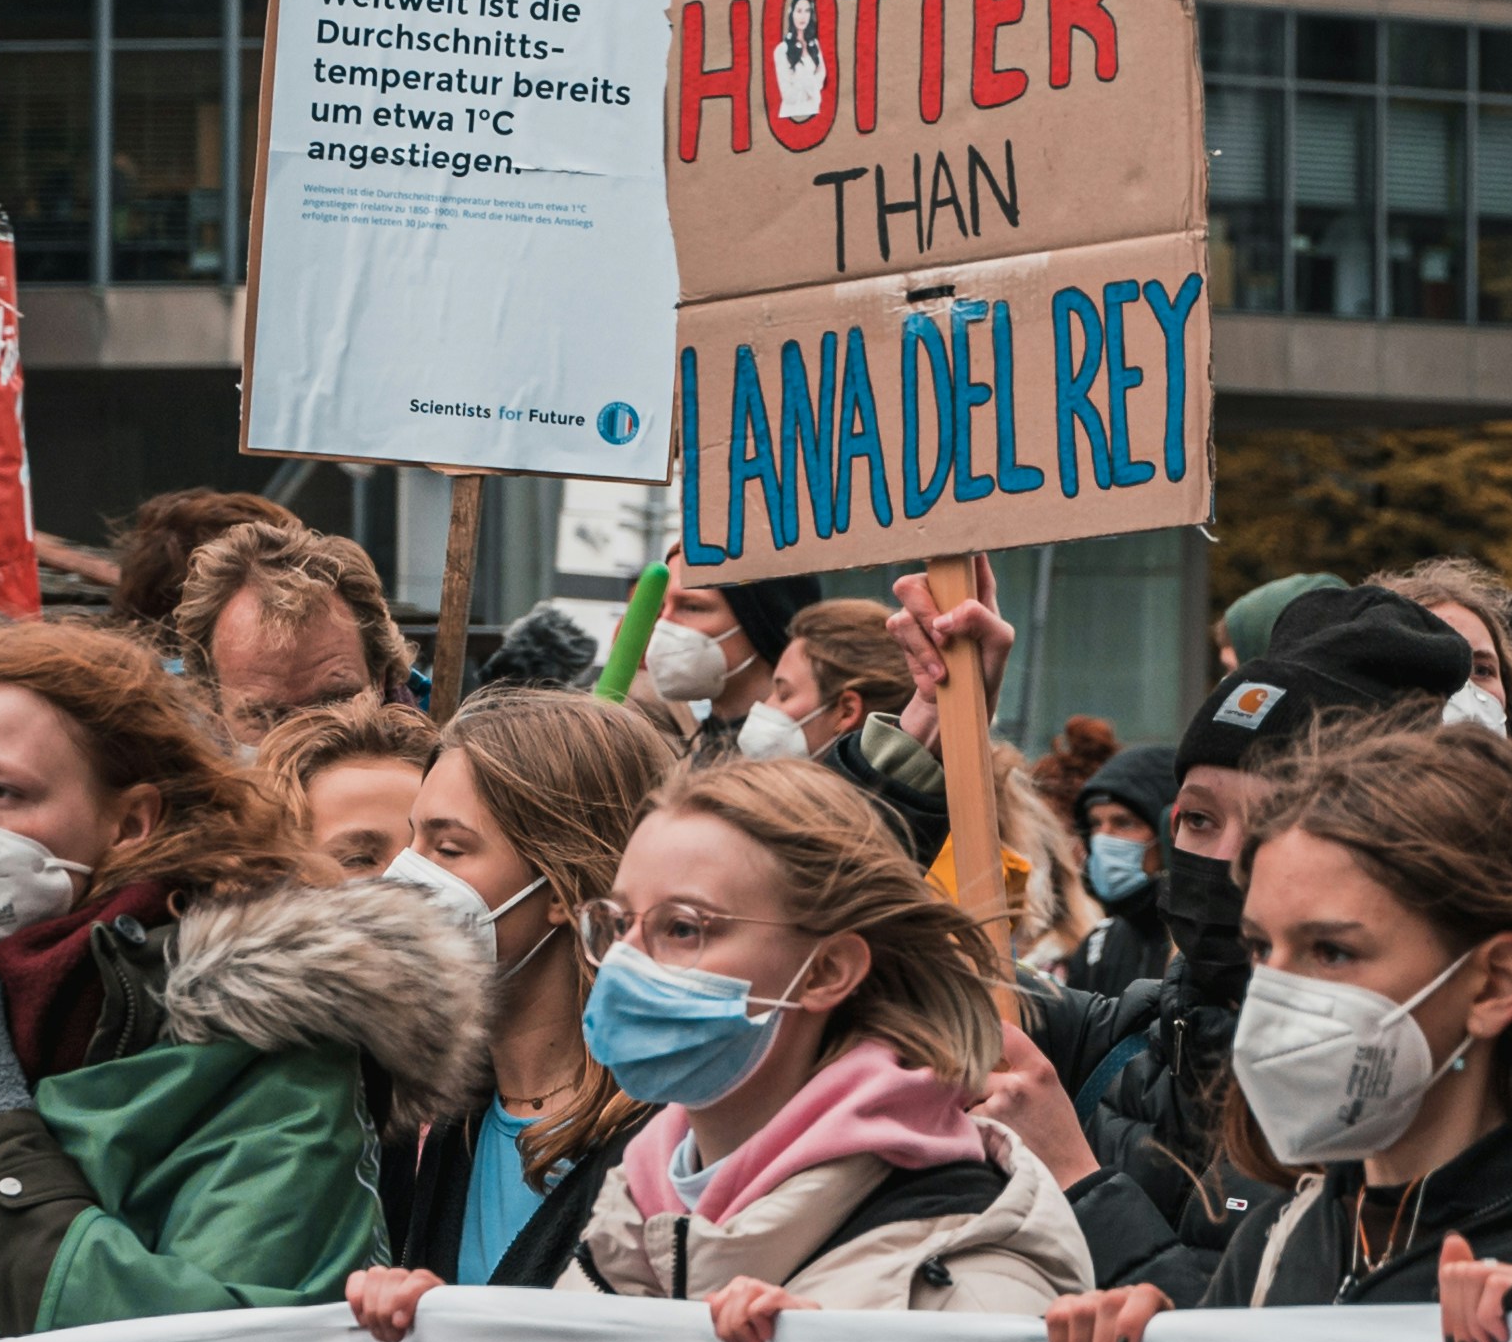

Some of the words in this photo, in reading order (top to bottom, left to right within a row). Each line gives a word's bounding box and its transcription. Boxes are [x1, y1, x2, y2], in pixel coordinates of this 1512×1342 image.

[317, 19, 565, 60] Durchschnitts-
[313, 58, 503, 96] temperatur
[513, 71, 631, 106] bereits
[311, 101, 362, 125] um
[373, 103, 454, 131] etwa
[465, 108, 515, 136] 1°C
[307, 140, 522, 178] angestiegen.
[813, 137, 1021, 274] THAN
[409, 398, 492, 419] Scientists
[498, 405, 523, 422] for
[528, 409, 586, 427] Future
[680, 325, 894, 566] LANA
[901, 297, 1046, 520] DEL
[1051, 272, 1205, 499] REY
